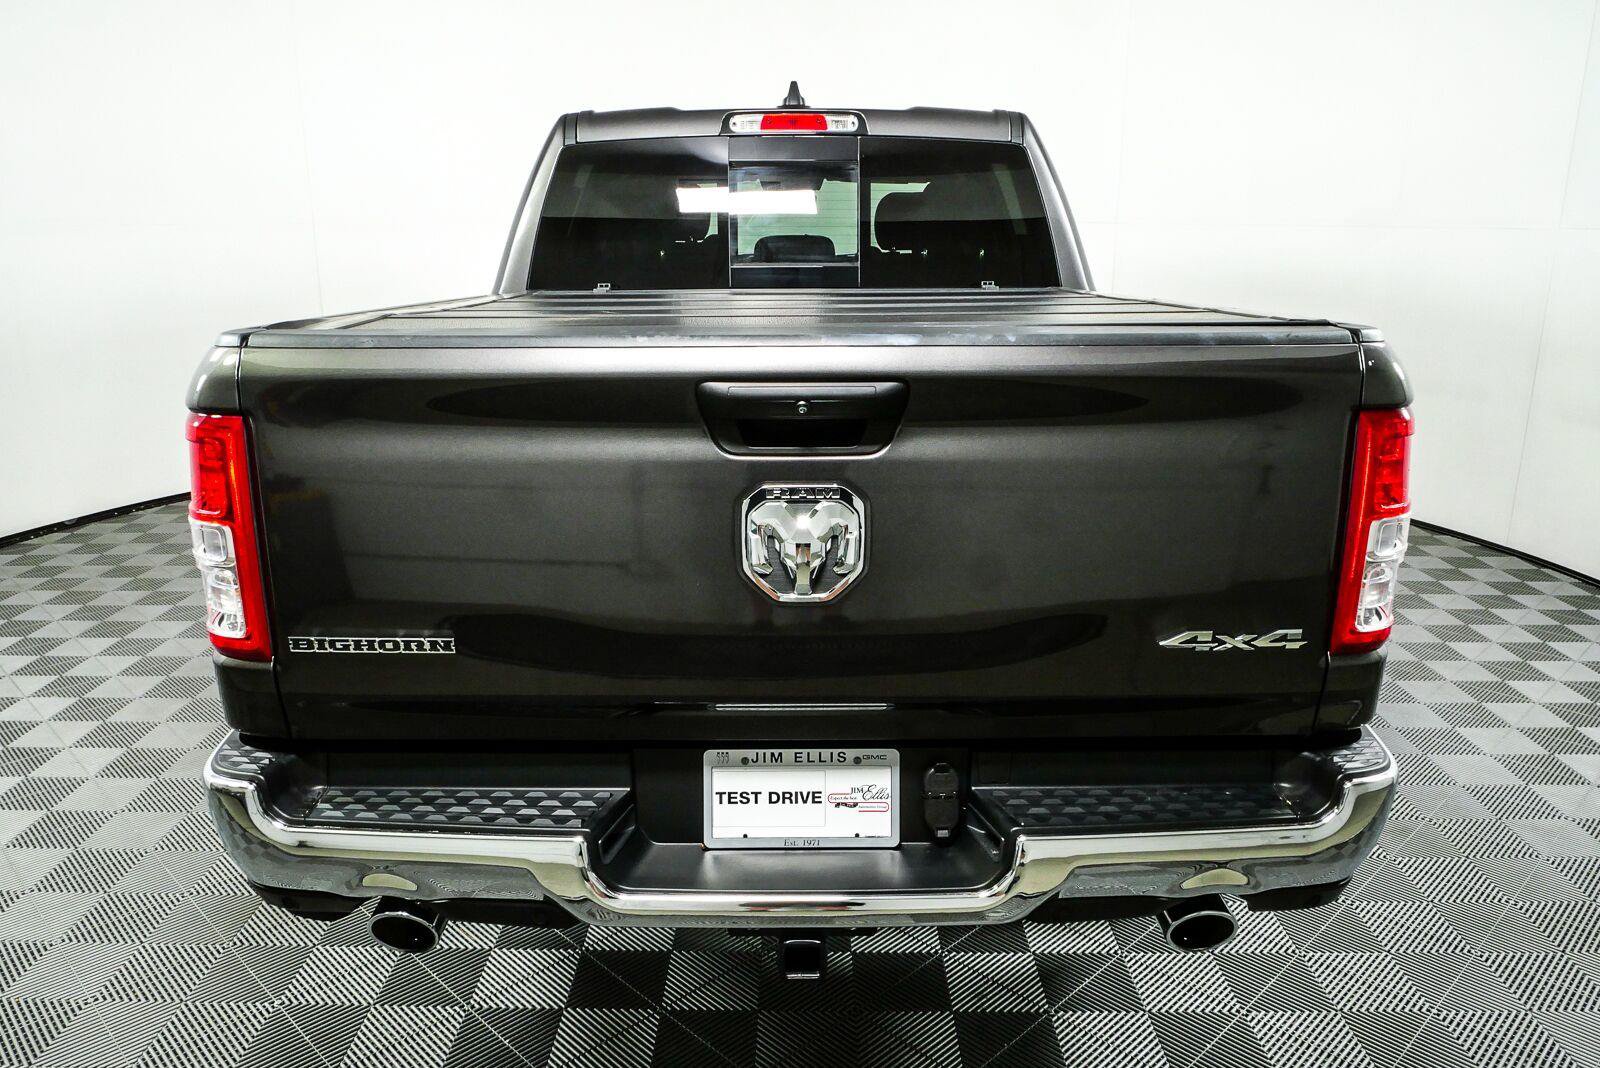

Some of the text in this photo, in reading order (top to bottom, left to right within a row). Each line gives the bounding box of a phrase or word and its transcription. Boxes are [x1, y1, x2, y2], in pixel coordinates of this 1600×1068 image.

[765, 487, 841, 499] RAM
[288, 636, 455, 653] BIGHORN
[751, 751, 847, 763] JIM ELLIS
[715, 791, 823, 805] TEST DRIVE
[850, 784, 890, 801] JIM Ellis
[803, 839, 820, 847] 1971
